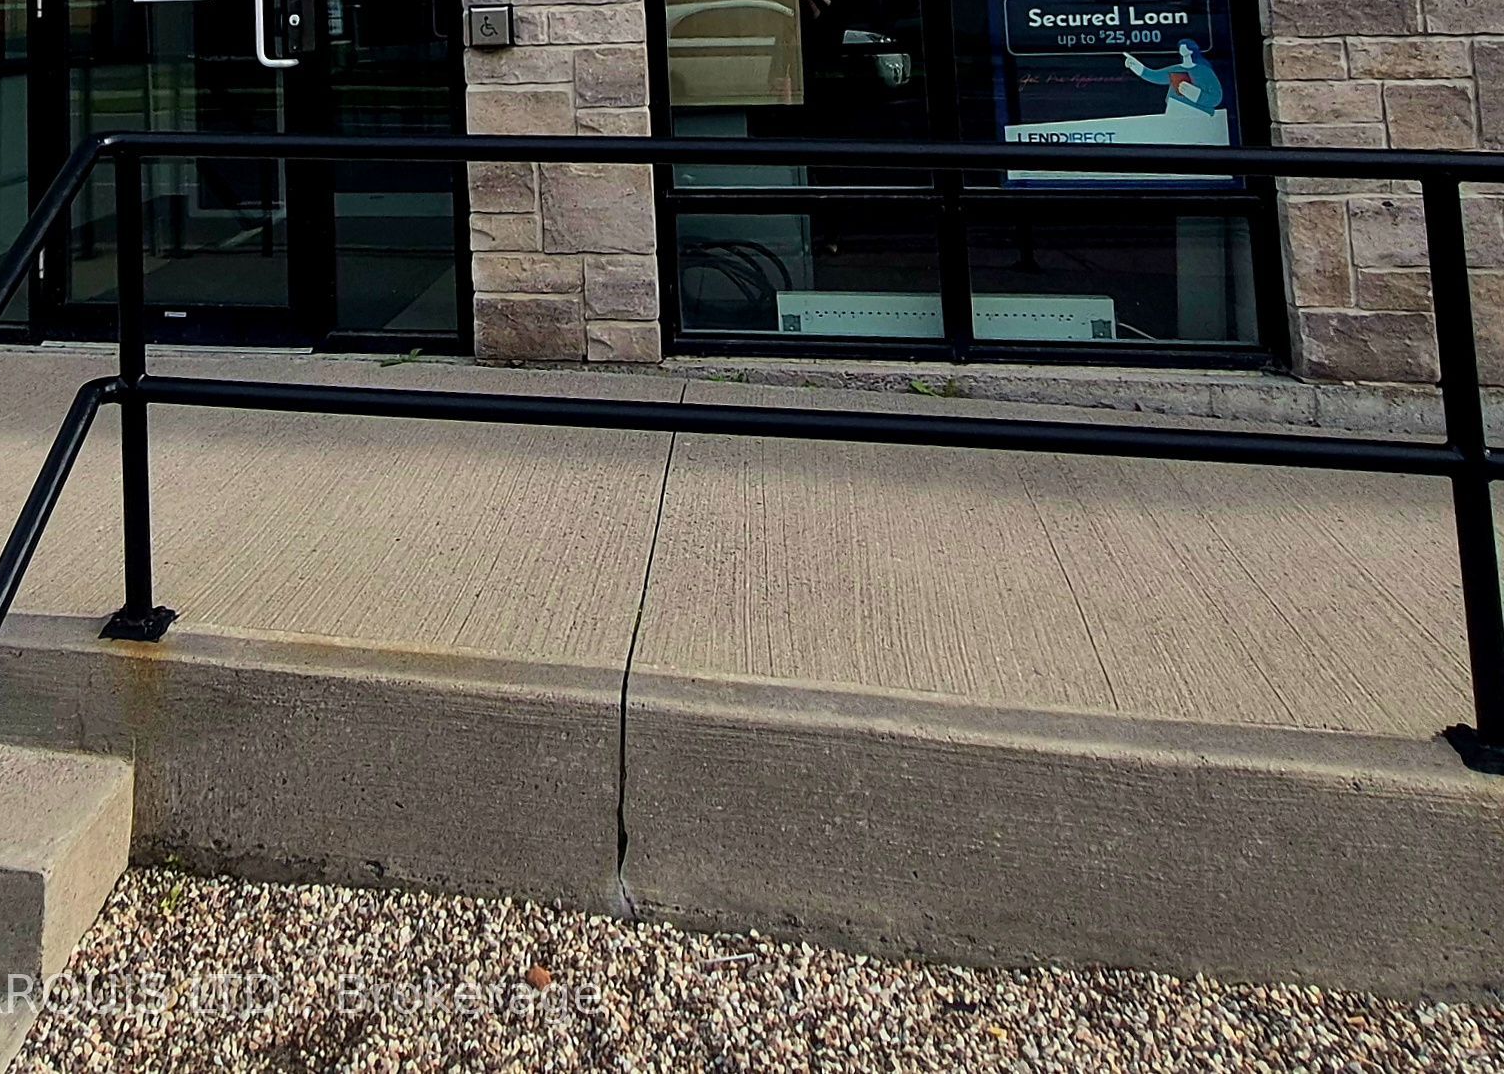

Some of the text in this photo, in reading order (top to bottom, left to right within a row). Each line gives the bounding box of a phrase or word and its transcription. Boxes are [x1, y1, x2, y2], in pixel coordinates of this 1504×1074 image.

[1028, 6, 1188, 26] Secured Loan
[1057, 30, 1161, 47] up to $25,000
